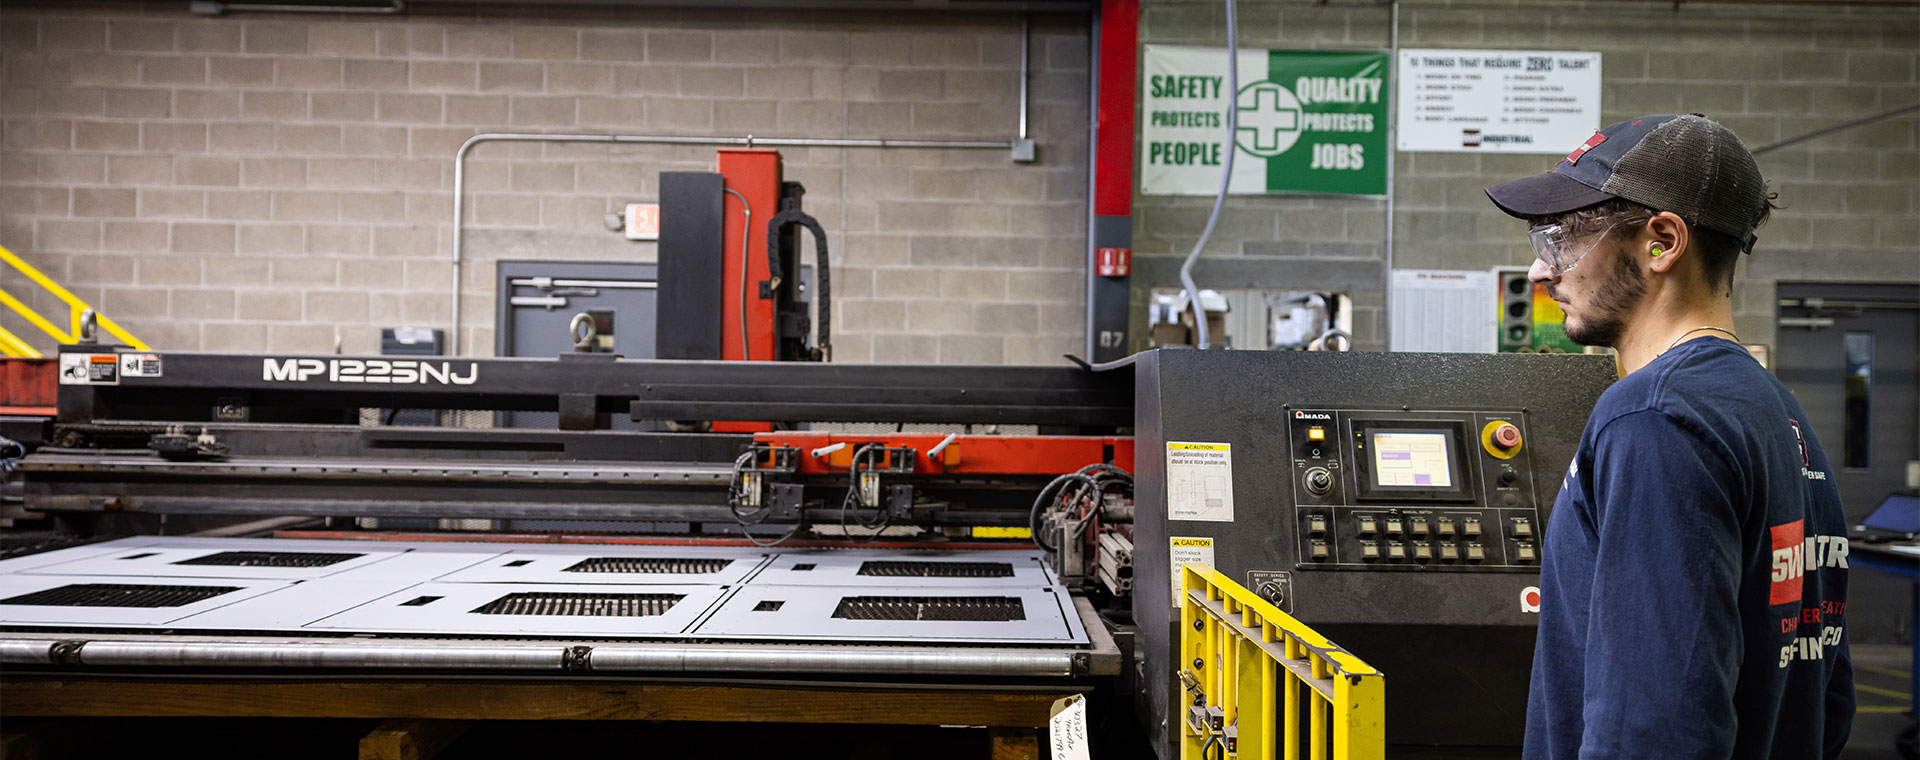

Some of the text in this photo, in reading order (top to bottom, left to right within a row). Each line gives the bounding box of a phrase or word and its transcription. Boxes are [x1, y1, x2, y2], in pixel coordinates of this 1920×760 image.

[1423, 57, 1455, 67] THINGS
[1460, 57, 1480, 68] THAT
[1484, 58, 1522, 69] REQUIRE
[1526, 56, 1554, 72] ZERO
[1559, 59, 1590, 70] TALENT
[1151, 75, 1223, 99] SAFETY
[1296, 76, 1383, 104] QUALITY
[1151, 109, 1221, 128] PROTECTS
[1302, 112, 1375, 132] PROTECTS
[1150, 142, 1222, 166] PEOPLE
[1311, 142, 1365, 170] JOBS
[1296, 410, 1331, 420] AMADA
